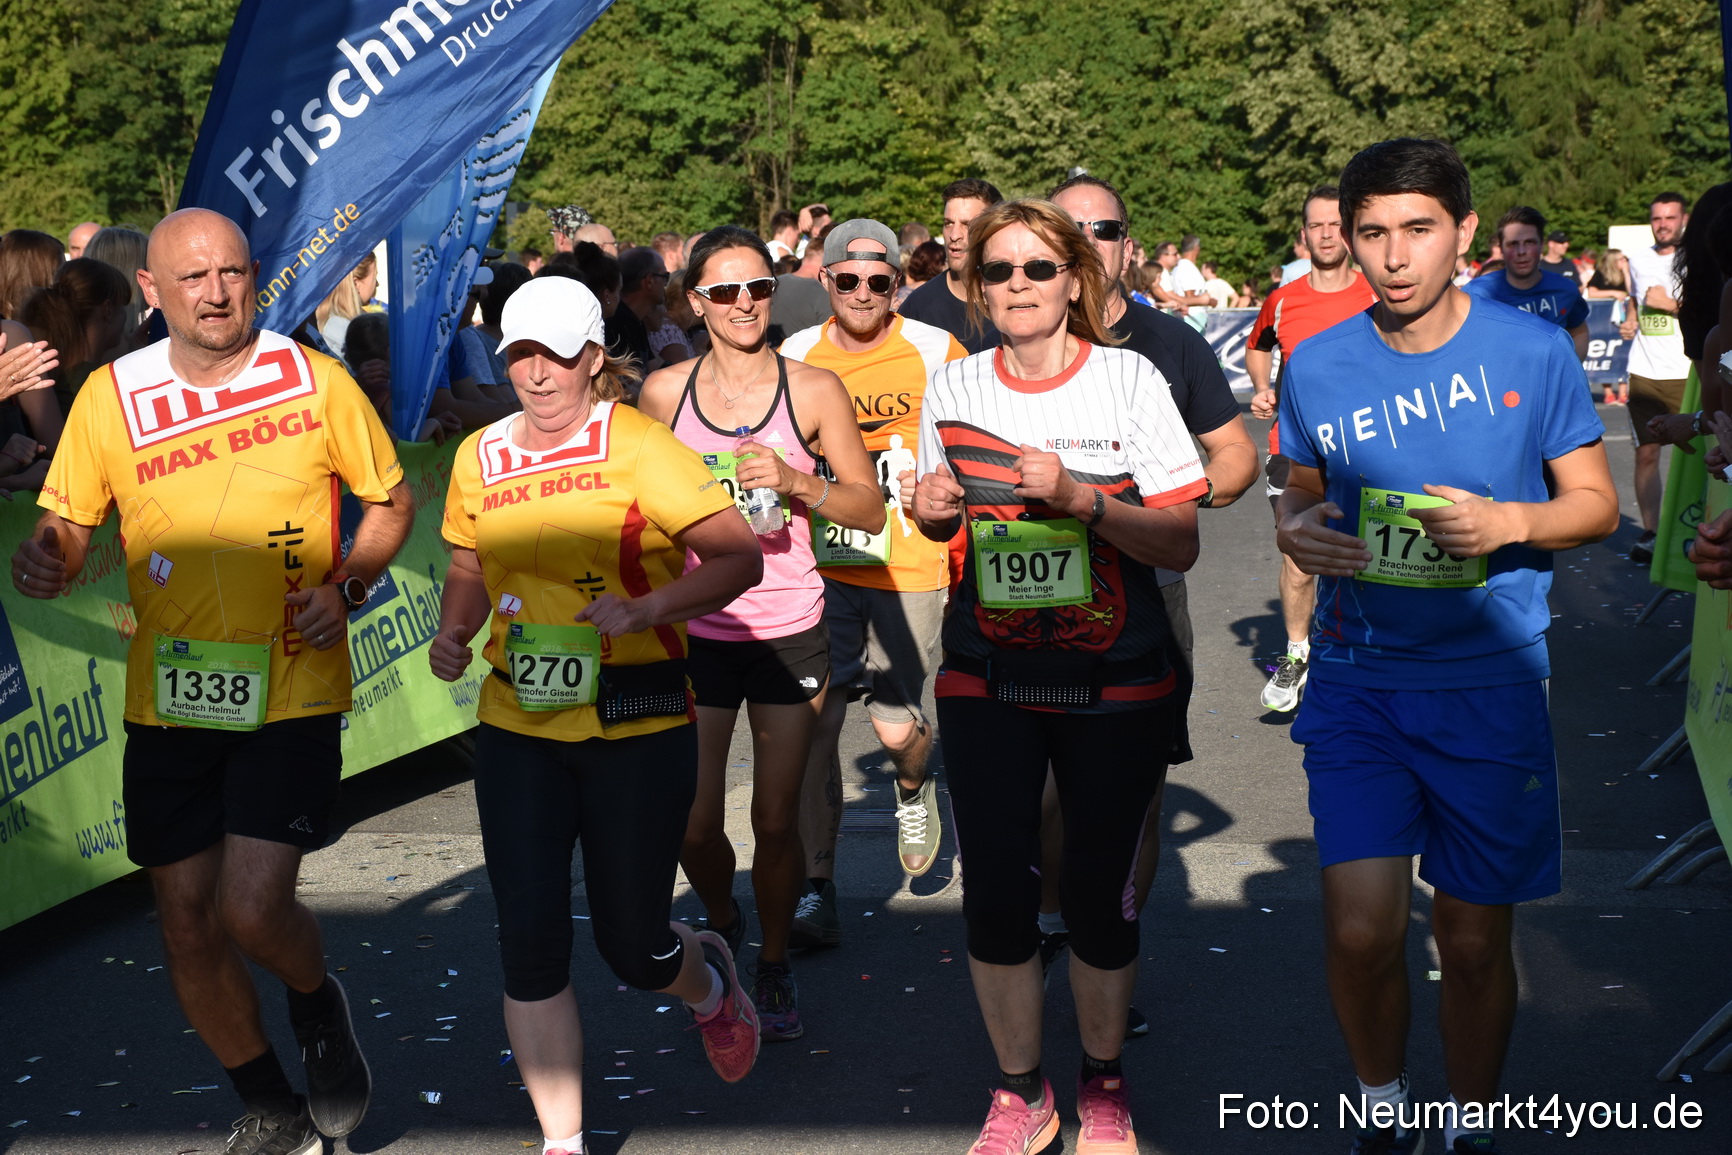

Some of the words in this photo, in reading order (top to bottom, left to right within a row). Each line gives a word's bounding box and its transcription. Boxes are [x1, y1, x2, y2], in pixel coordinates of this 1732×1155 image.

[224, 0, 470, 217] Frischm
[1642, 317, 1667, 328] 1789
[136, 438, 218, 485] MAX
[227, 408, 323, 454] BÖGL
[1046, 438, 1110, 450] NEUMARKT
[481, 484, 531, 513] MAX
[540, 471, 610, 498] BÖGL
[1375, 524, 1467, 562] 173
[989, 550, 1072, 583] 1907
[1378, 567, 1394, 576] Rena
[1396, 570, 1440, 580] Technologies
[1379, 558, 1435, 573] Brachvogel
[1008, 585, 1032, 593] Meier
[1034, 584, 1054, 594] Inge
[509, 652, 583, 688] 1270
[165, 669, 250, 706] 1338
[353, 666, 403, 717] neumarkt
[550, 689, 578, 697] Gisela
[171, 700, 206, 712] Aurbach
[208, 705, 241, 715] Helmut
[178, 710, 190, 718] Bögl
[193, 712, 224, 721] Bauservice
